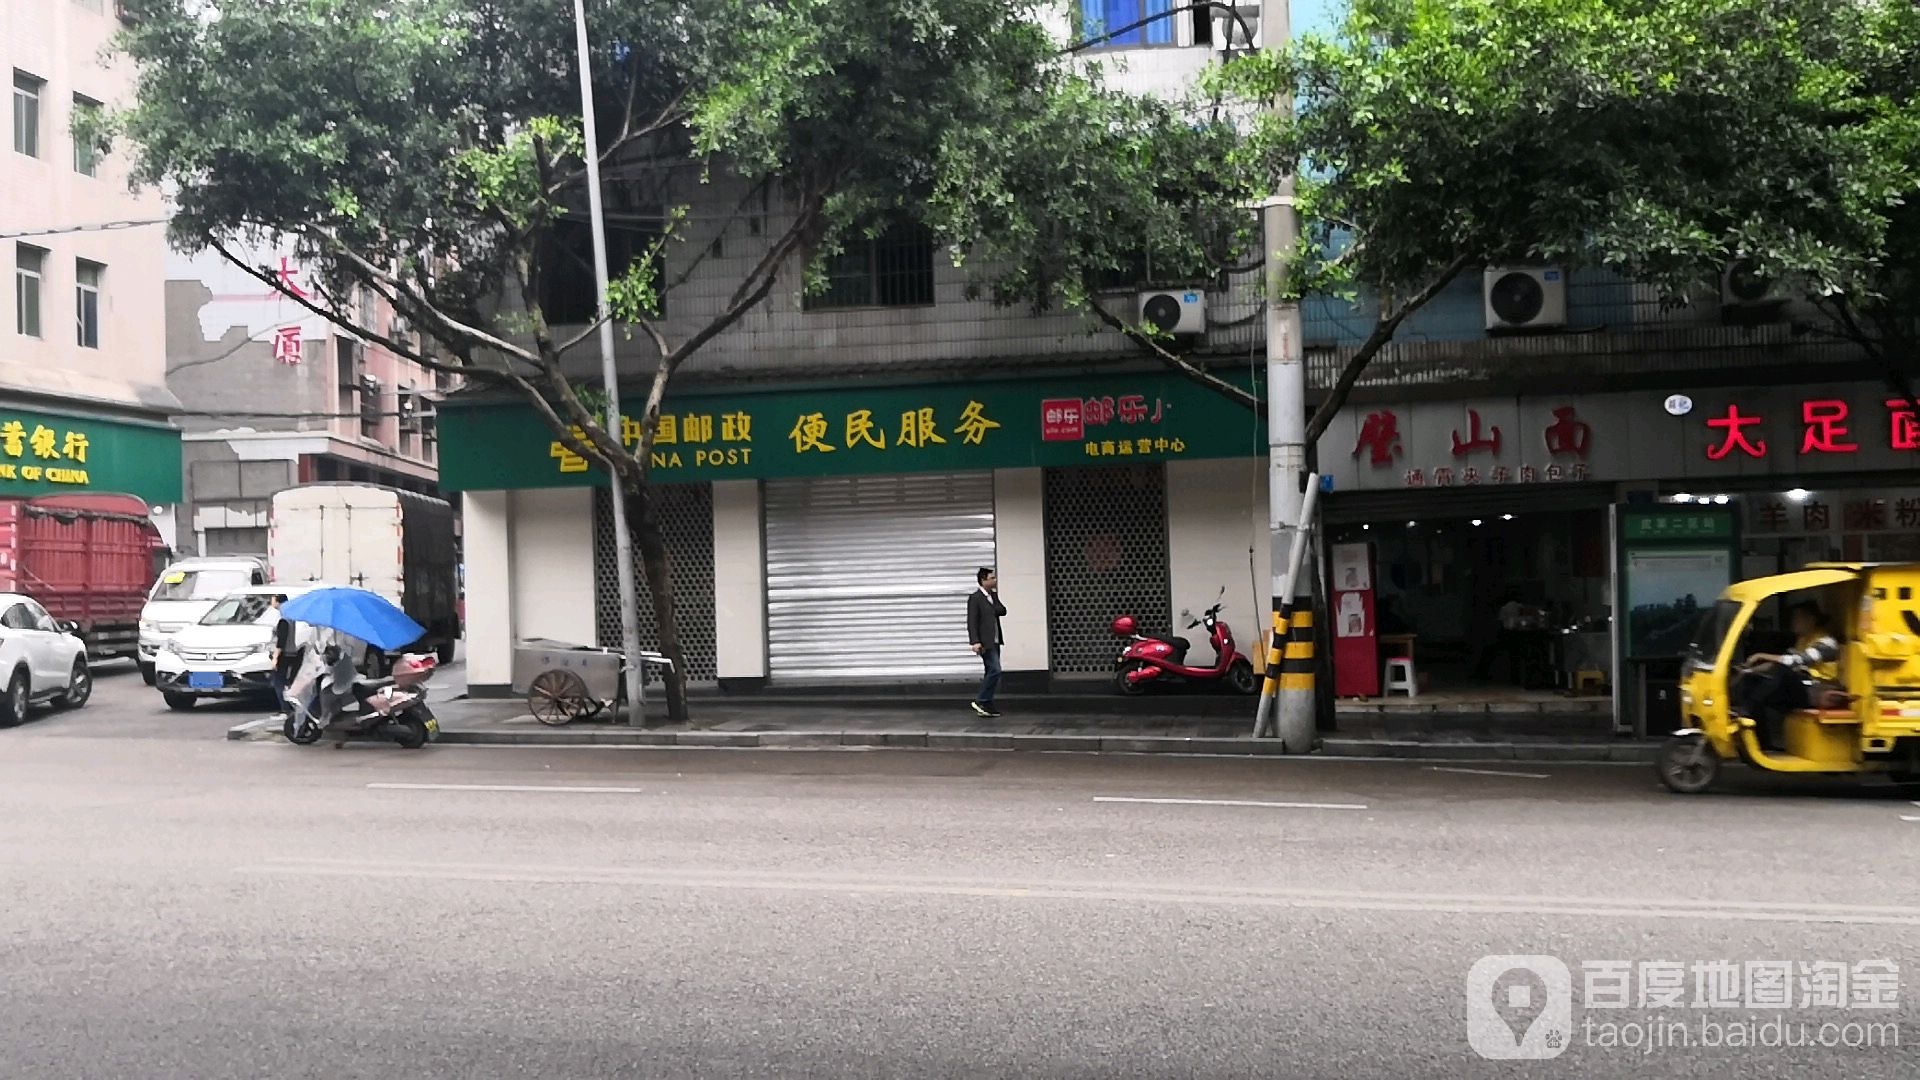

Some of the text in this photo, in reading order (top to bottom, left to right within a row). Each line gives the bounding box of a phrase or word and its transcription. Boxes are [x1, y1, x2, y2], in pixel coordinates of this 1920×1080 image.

[787, 399, 1001, 455] 便民服务
[1085, 437, 1186, 457] 电商运营中心
[695, 448, 752, 467] POST
[21, 465, 43, 481] OF
[45, 467, 90, 485] CHINA
